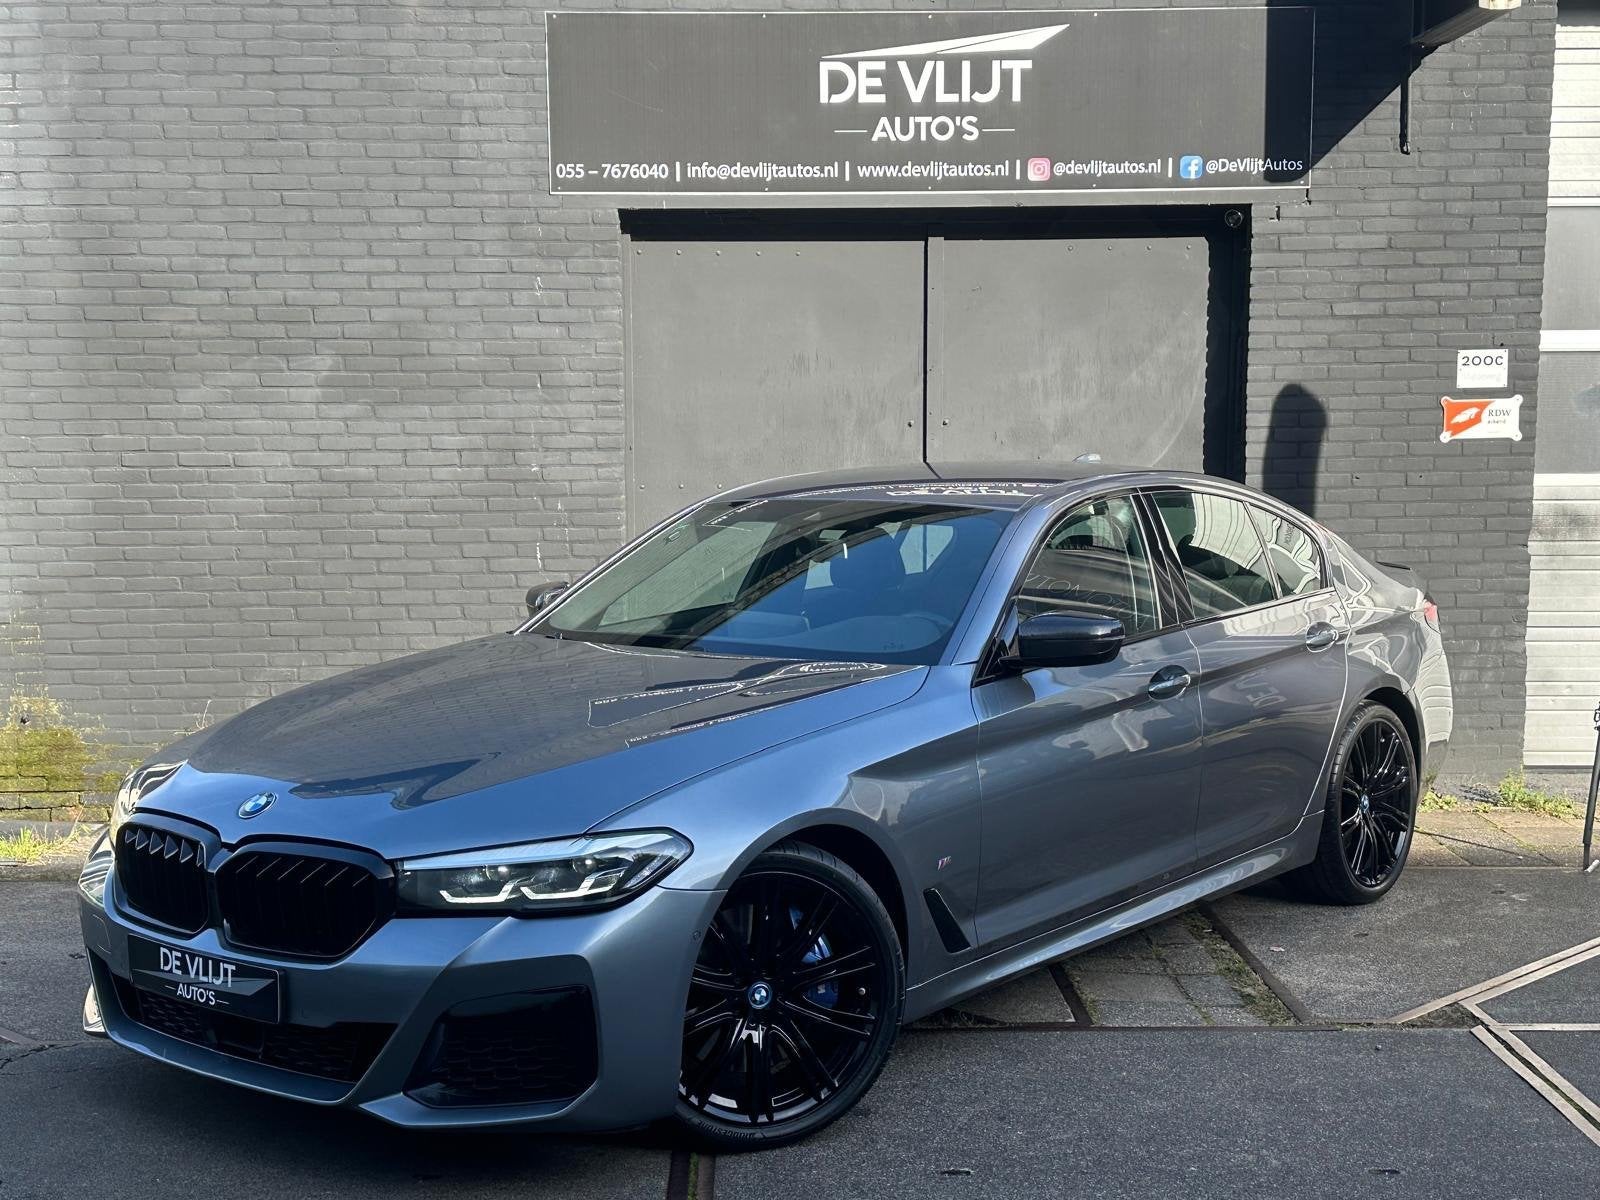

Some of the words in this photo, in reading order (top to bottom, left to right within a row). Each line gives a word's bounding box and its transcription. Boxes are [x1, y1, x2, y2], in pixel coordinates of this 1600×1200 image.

[820, 60, 886, 103] DE
[897, 59, 1033, 103] VLIJT
[871, 115, 980, 142] AUTO'S
[556, 163, 584, 179] 055
[601, 163, 669, 179] 7676040
[687, 161, 839, 182] info@devlijtautos.nl
[857, 160, 1010, 180] www.devlijtautos.nl
[1053, 158, 1162, 177] @devlijtautos.nl
[1205, 157, 1304, 176] @DeVlijtAutos
[1488, 408, 1512, 417] RDW
[160, 947, 182, 975] DE
[185, 954, 236, 987] VLIJT
[176, 983, 216, 1006] AUTO'S
